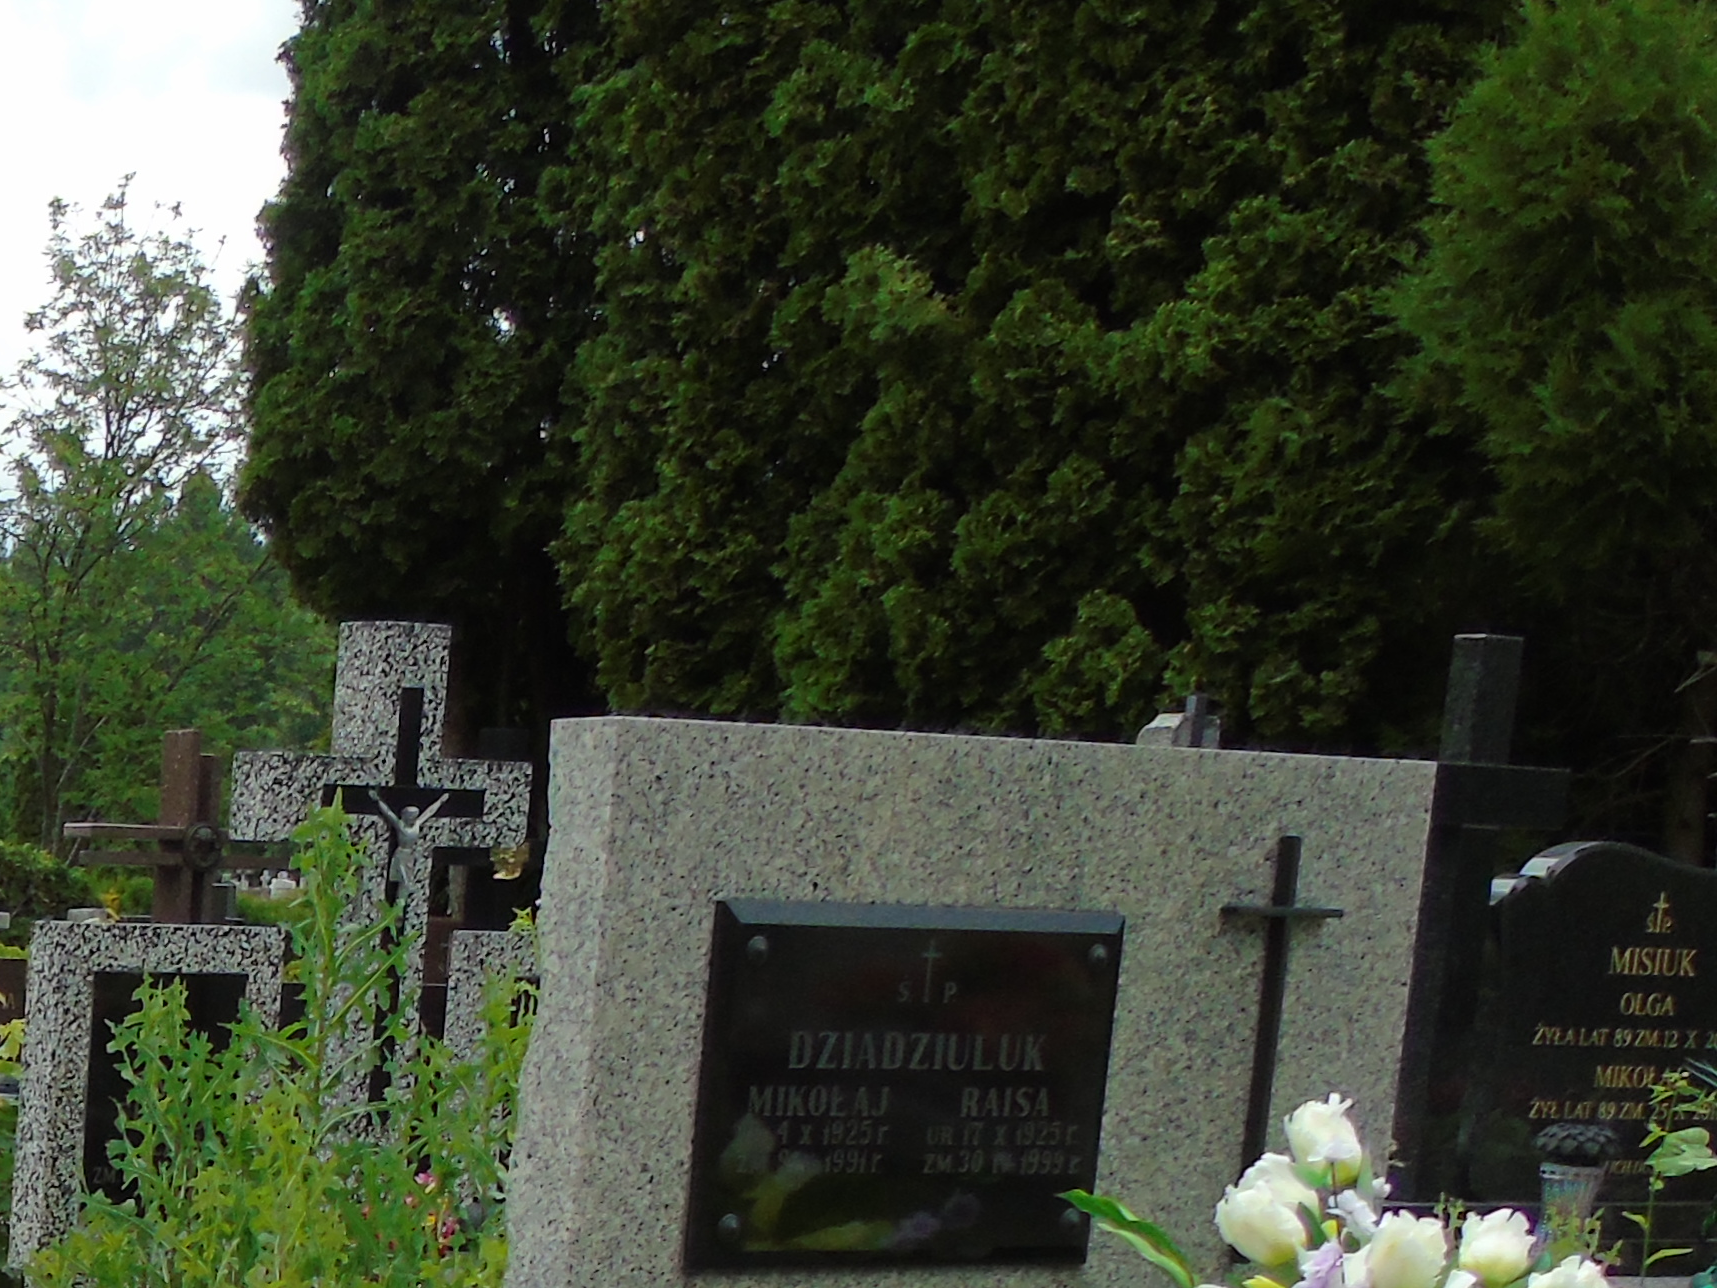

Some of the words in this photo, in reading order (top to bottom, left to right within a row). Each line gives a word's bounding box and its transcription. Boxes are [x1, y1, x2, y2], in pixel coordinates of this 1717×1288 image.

[1608, 947, 1698, 977] MISIUK
[1620, 991, 1675, 1017] OLGA
[1532, 1024, 1575, 1046] ŻYŁA
[1578, 1028, 1610, 1047] LAT
[1613, 1028, 1633, 1048] 89
[787, 1030, 1049, 1072] DZIADZIULUK
[1593, 1064, 1669, 1089] MIKOŁ
[749, 1085, 892, 1117] MIKOŁAJ
[960, 1086, 1050, 1118] RAISA
[1565, 1100, 1593, 1120] LAT
